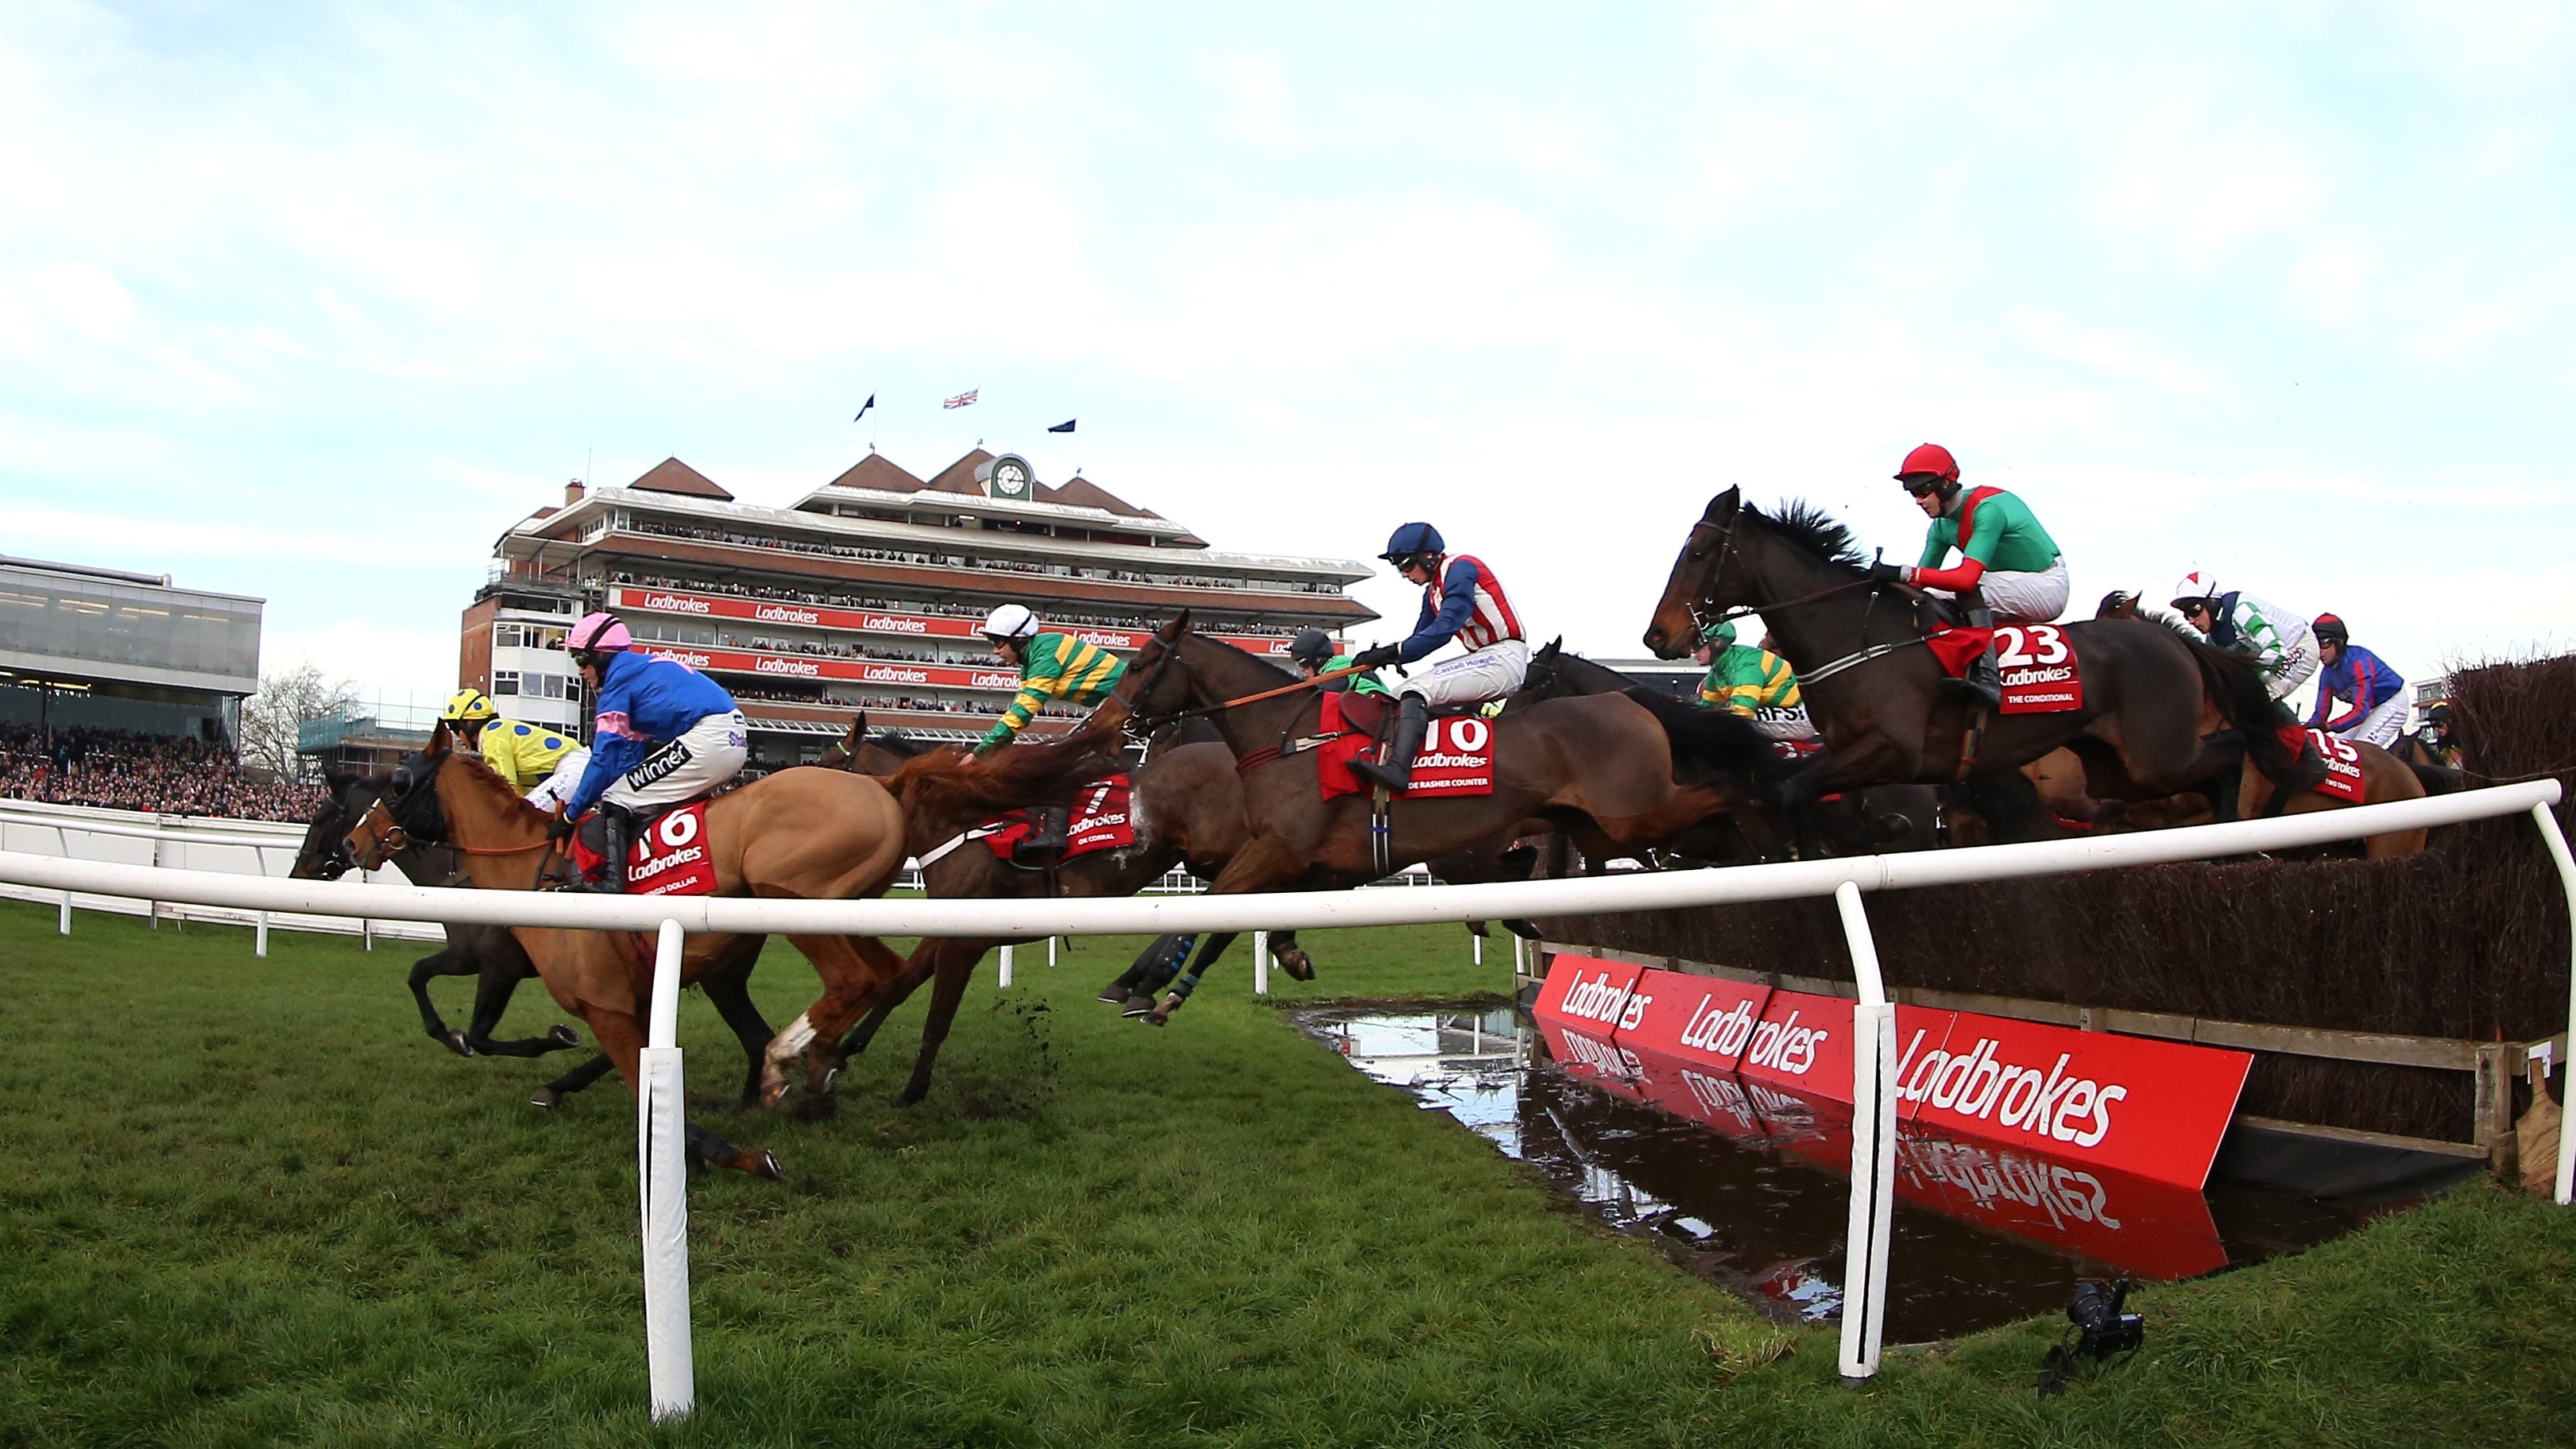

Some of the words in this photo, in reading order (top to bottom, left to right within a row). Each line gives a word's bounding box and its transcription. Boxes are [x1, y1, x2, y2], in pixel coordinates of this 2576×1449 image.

[644, 593, 710, 613] Ladbrokes
[756, 605, 818, 624] Ladbrokes
[862, 615, 926, 632] Ladbrokes
[1073, 630, 1131, 646] Ladbrokes
[1994, 625, 2068, 667] 23
[756, 656, 819, 675] Ladbrokes
[863, 665, 927, 682] Ladbrokes
[971, 672, 1021, 687] Ladbrok
[2000, 666, 2072, 686] Ladbrokes
[2025, 694, 2074, 703] CONDITIONAL
[1425, 718, 1488, 752] 10
[2306, 728, 2359, 762] 15
[629, 744, 686, 787] winner
[1411, 752, 1487, 768] Ladbrokes
[2322, 757, 2361, 778] dbrokes
[1451, 778, 1488, 786] COUNTER
[639, 806, 698, 861] 16
[1066, 813, 1126, 837] adbrokes
[1089, 833, 1115, 842] CORRAL
[628, 845, 702, 882] Ladbrokes
[666, 875, 698, 891] DOLLAR
[1561, 968, 1654, 1031] Ladbrokes
[1680, 993, 1829, 1076] Ladbrokes
[1896, 1029, 2128, 1148] Ladbrokes
